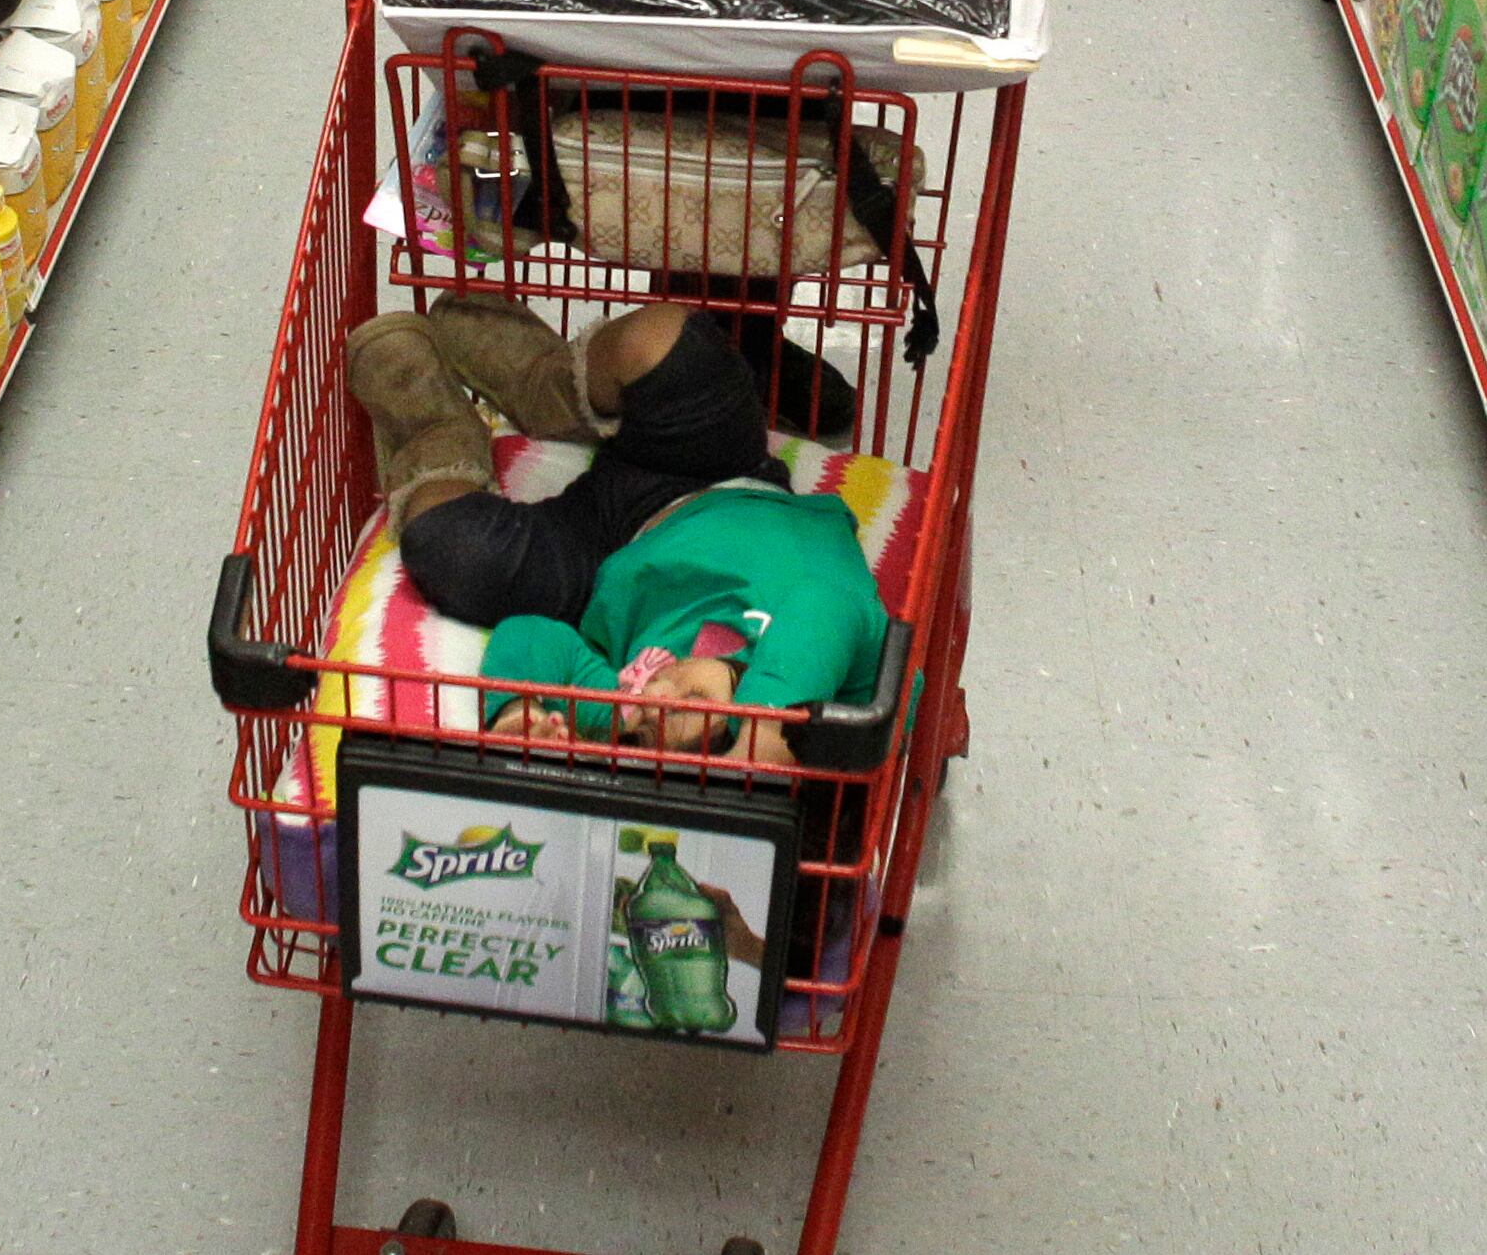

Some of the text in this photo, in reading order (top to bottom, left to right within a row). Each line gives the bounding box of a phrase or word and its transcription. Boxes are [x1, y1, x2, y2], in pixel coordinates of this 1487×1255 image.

[406, 841, 527, 883] Sprite
[381, 905, 486, 926] NO CAFFEINE
[420, 901, 493, 920] NATURAL
[499, 913, 568, 929] FLAVORS
[378, 919, 563, 961] PERFECTLY
[649, 930, 702, 951] Sprite
[375, 944, 540, 986] CLEAR
